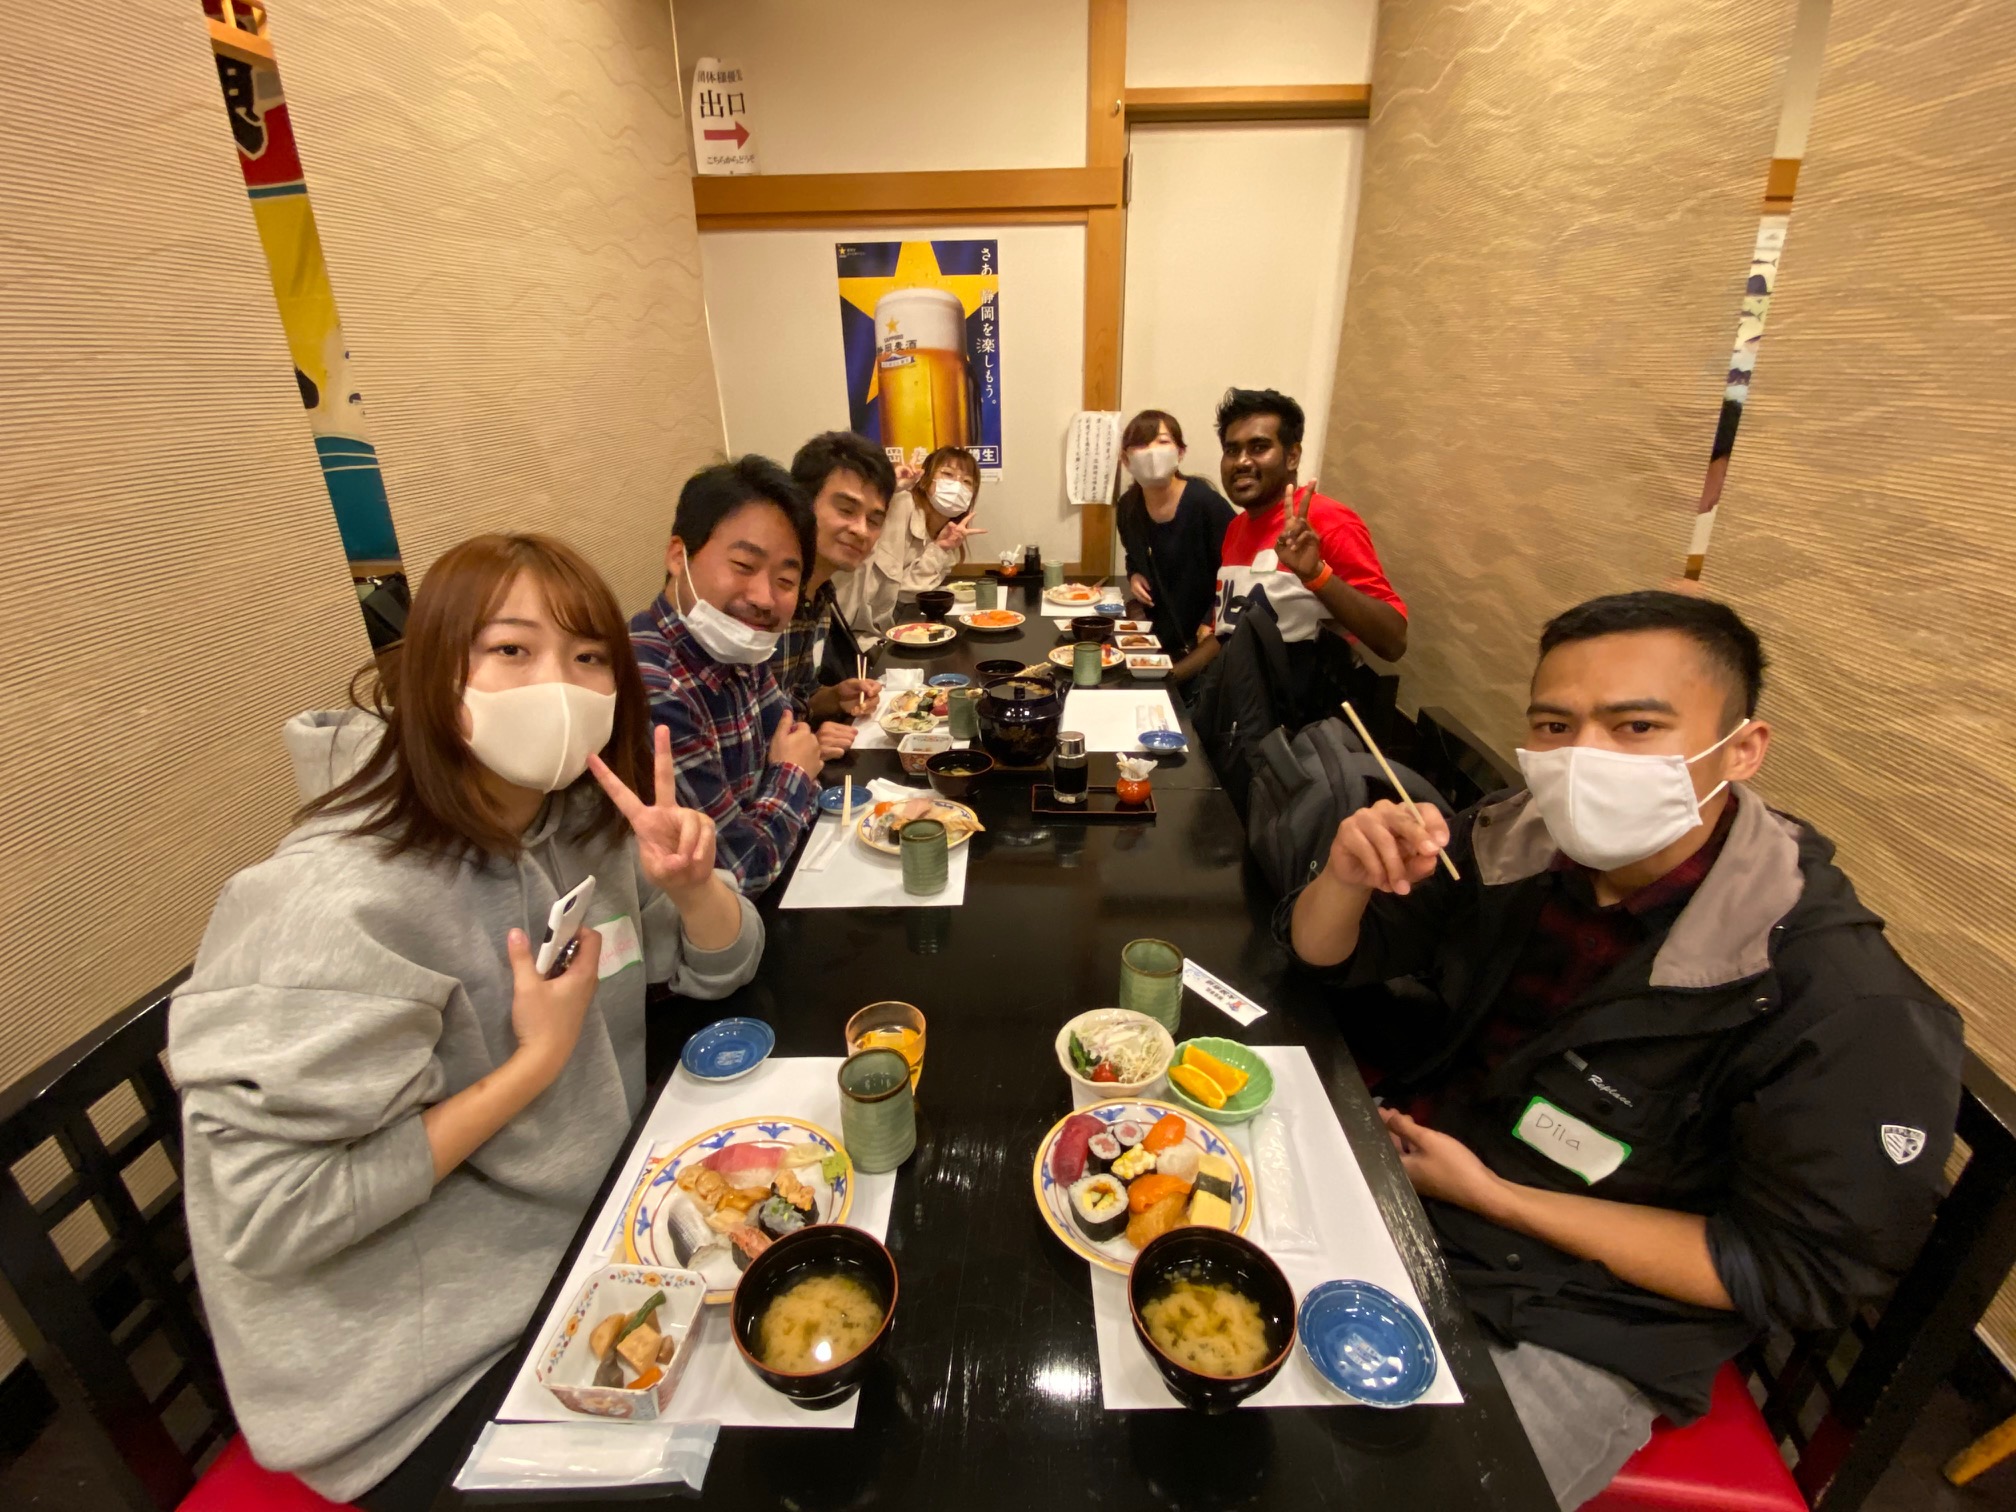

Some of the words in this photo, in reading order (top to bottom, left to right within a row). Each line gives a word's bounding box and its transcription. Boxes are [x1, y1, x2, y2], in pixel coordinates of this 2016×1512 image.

[700, 90, 745, 118] 出口
[980, 247, 993, 276] さあ
[980, 289, 997, 404] 静岡を楽しもう。
[1535, 1113, 1582, 1152] Dila
